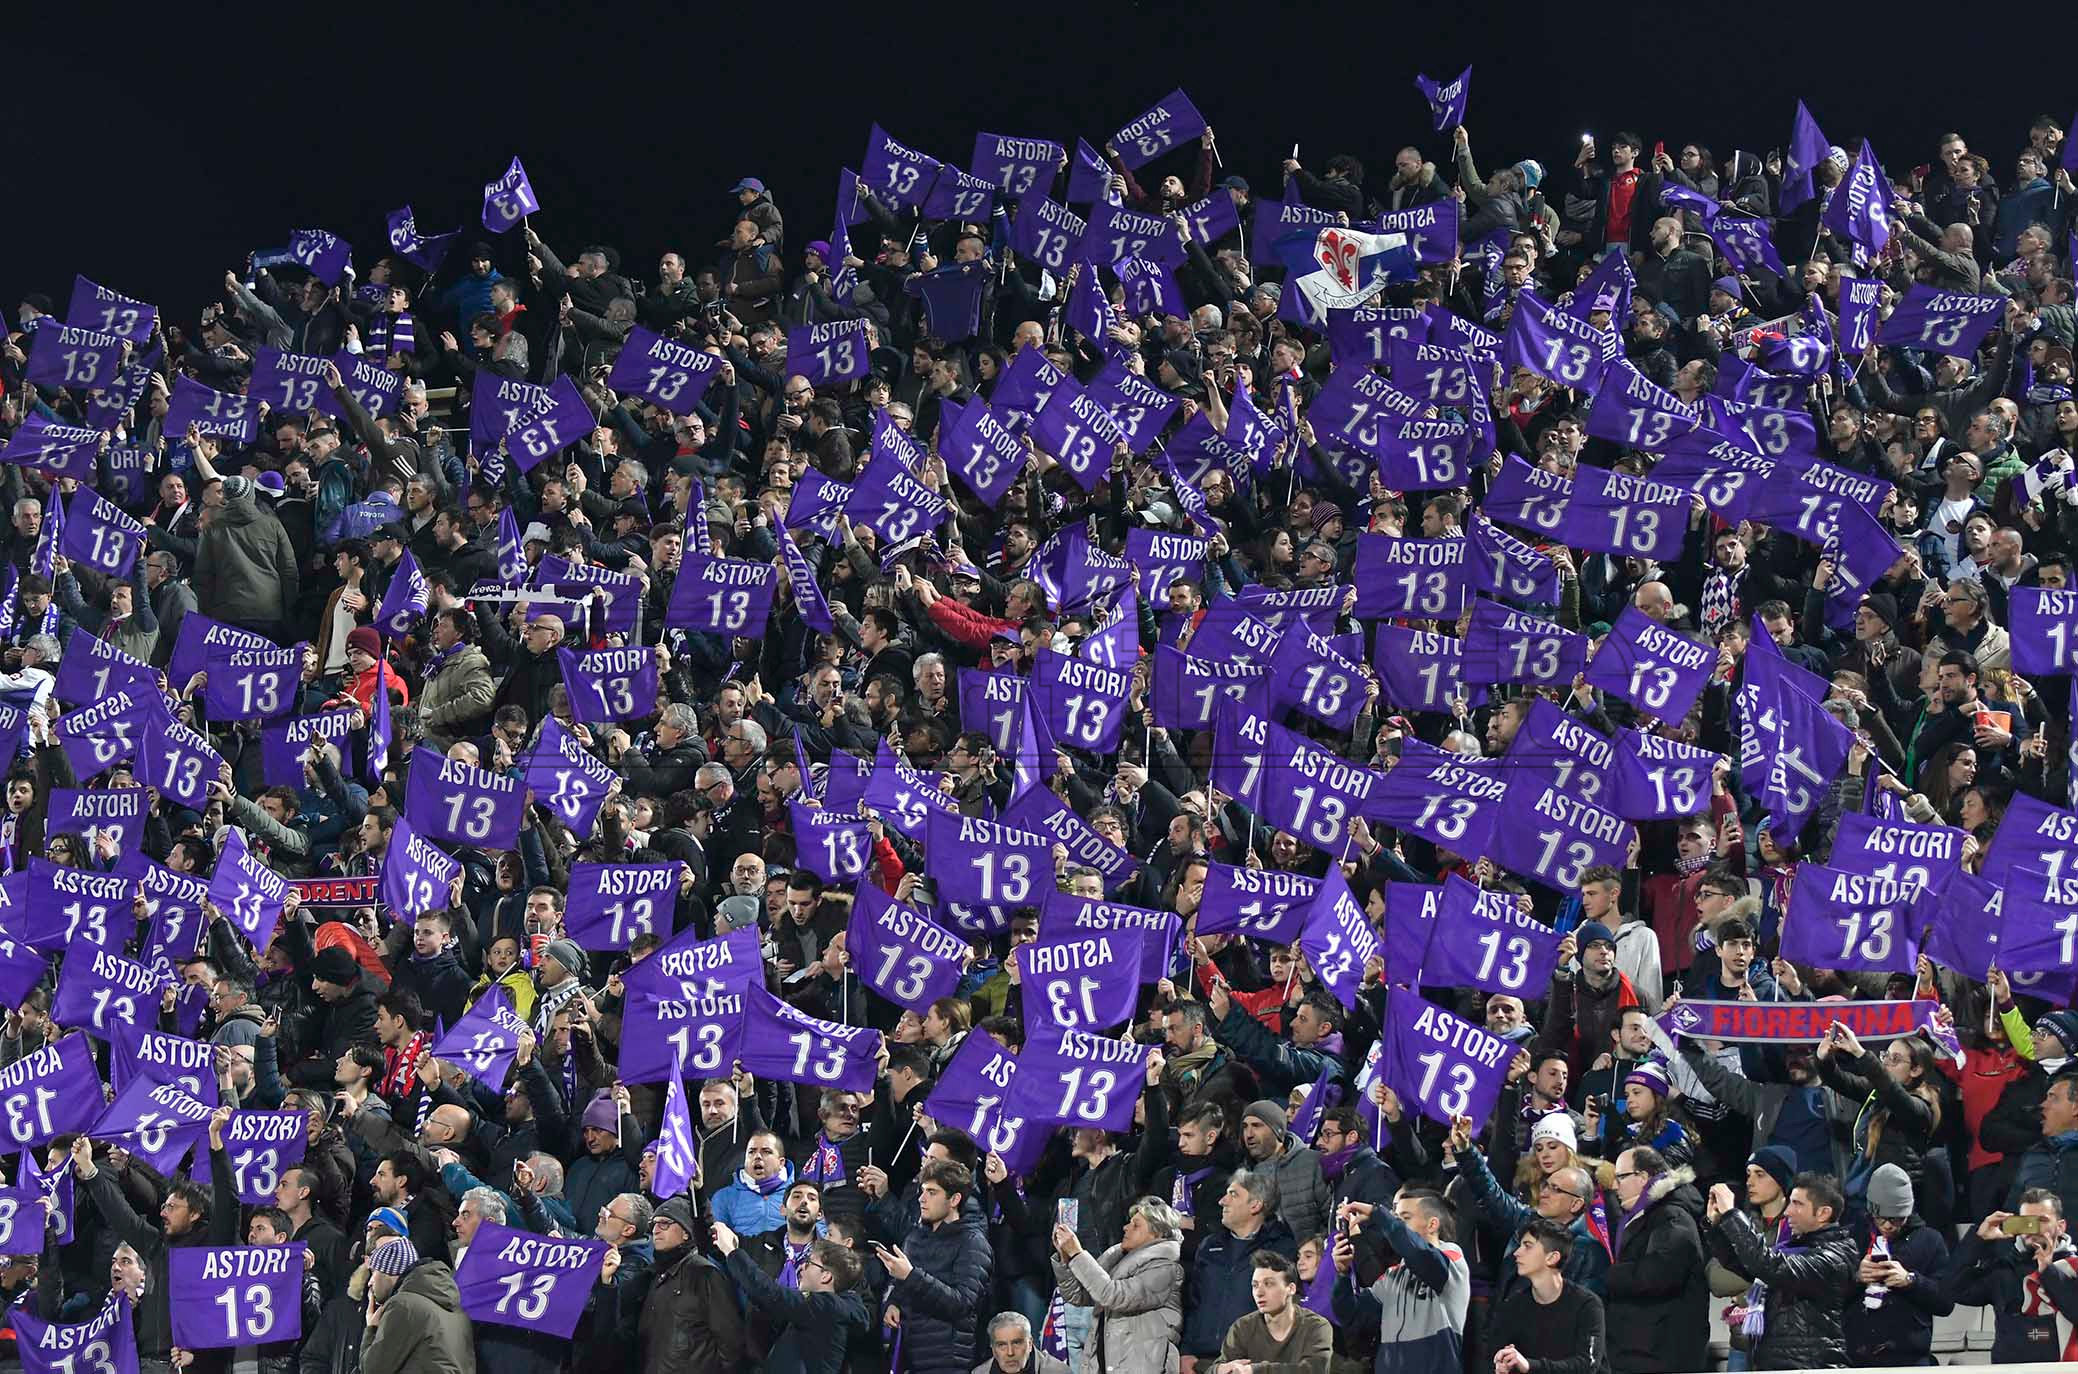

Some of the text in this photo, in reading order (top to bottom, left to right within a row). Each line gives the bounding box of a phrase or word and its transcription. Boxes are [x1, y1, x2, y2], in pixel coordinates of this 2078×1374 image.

[995, 138, 1052, 162] ASTORI
[888, 162, 920, 195] 13
[1000, 163, 1036, 193] 13
[953, 190, 985, 216] 13
[1037, 199, 1087, 237] ASTORI
[1109, 211, 1167, 236] ASTORI
[1034, 228, 1068, 267] 13
[1850, 282, 1877, 304] ASTORI
[1926, 294, 1999, 313] ASTORI
[100, 307, 138, 334] 13
[809, 317, 863, 345] ASTORI
[1852, 312, 1868, 347] 13
[62, 350, 101, 383] 13
[276, 353, 330, 375] ASTOR
[647, 339, 713, 372] ASTORI
[817, 341, 855, 377] 13
[1543, 338, 1592, 382] 13
[279, 379, 317, 410] 13
[356, 361, 398, 392] ASTORI
[645, 366, 687, 401] 13
[1114, 375, 1173, 410] ASTORI
[1352, 373, 1418, 416] ASTORI
[1424, 367, 1467, 401] 13
[42, 424, 101, 443] ASTORI
[976, 413, 1021, 462] ASTORI
[1068, 393, 1120, 446] ASTORI
[1343, 403, 1386, 446] 13
[1398, 420, 1467, 440] ASTORI
[1628, 407, 1673, 446] 13
[881, 424, 922, 470] ASTORI
[963, 443, 1000, 489] 13
[1059, 424, 1097, 474] 13
[1407, 444, 1455, 482] 13
[888, 472, 946, 516] ASTORI
[1602, 475, 1683, 506] ASTORI
[1692, 467, 1745, 506] 13
[1800, 463, 1879, 503] ASTORI
[92, 499, 146, 530] ASTORI
[360, 511, 386, 519] TOYOTA
[878, 502, 918, 543] 13
[1519, 495, 1570, 528] 13
[1608, 506, 1660, 552] 13
[90, 526, 124, 568] 13
[1387, 542, 1465, 564] ASTORI
[563, 563, 634, 586] ASTORI
[704, 560, 772, 587] ASTORI
[1398, 572, 1448, 613] 13
[1492, 550, 1535, 595] 13
[704, 590, 750, 630] 13
[1263, 587, 1335, 607] ASTORI
[578, 649, 648, 673] ASTORI
[1509, 637, 1562, 680] 13
[1636, 624, 1708, 668] ASTORI
[237, 672, 279, 713] 13
[592, 678, 634, 717] 13
[1058, 661, 1127, 698] ASTORI
[1303, 665, 1349, 716] 13
[1628, 660, 1677, 708] 13
[164, 718, 217, 759] ASTORI
[286, 711, 352, 743] ASTORI
[1064, 695, 1108, 742] 13
[163, 750, 201, 797] 13
[438, 758, 514, 793] ASTORI
[559, 735, 615, 785] ASTORI
[1289, 745, 1374, 800] ASTORI
[550, 769, 589, 818] 13
[1553, 759, 1602, 802] 13
[1648, 767, 1697, 815] 13
[72, 794, 138, 817] ASTORI
[443, 793, 496, 838] 13
[1292, 784, 1346, 844] 13
[1415, 794, 1478, 840] 13
[1535, 787, 1627, 846] ASTORI
[960, 817, 1047, 846] ASTORI
[1043, 808, 1125, 876] ASTORI
[1864, 825, 1953, 860] ASTORI
[405, 832, 452, 883] ASTORI
[822, 830, 862, 875] 13
[1535, 829, 1596, 889] 13
[53, 869, 128, 899] ASTORI
[144, 865, 208, 903] ASTOR
[237, 850, 284, 901] ASTORI
[296, 882, 379, 902] ORENT
[597, 868, 672, 895] ASTORI
[972, 851, 1031, 903] 13
[1231, 868, 1314, 897] ASTORI
[1830, 874, 1921, 905] ASTORI
[63, 901, 108, 945] 13
[233, 882, 263, 932] 13
[604, 898, 653, 944] 13
[1075, 903, 1168, 930] ASTORI
[877, 903, 972, 962] ASTORI
[1333, 891, 1379, 967] ASTORI
[1837, 910, 1895, 960] 13
[92, 951, 162, 995] ASTORI
[874, 943, 933, 1001] 13
[1319, 930, 1353, 986] 13
[1477, 930, 1533, 989] 13
[657, 998, 742, 1020] ASTORI
[1711, 1004, 1915, 1037] FIORENTINA
[137, 1034, 211, 1067] ASTOR
[667, 1023, 725, 1071] 13
[789, 1031, 847, 1080] 13
[1057, 1029, 1143, 1064] ASTORI
[1413, 1005, 1508, 1068] ASTORI
[1057, 1066, 1116, 1120] 13
[1416, 1050, 1478, 1120] 13
[229, 1115, 302, 1140] ASTORI
[234, 1148, 279, 1197] 13
[202, 1248, 291, 1280] ASTORI
[497, 1236, 591, 1270] ASTORI
[215, 1284, 275, 1340] 13
[495, 1271, 558, 1320] 13
[40, 1299, 122, 1350] ASTORI
